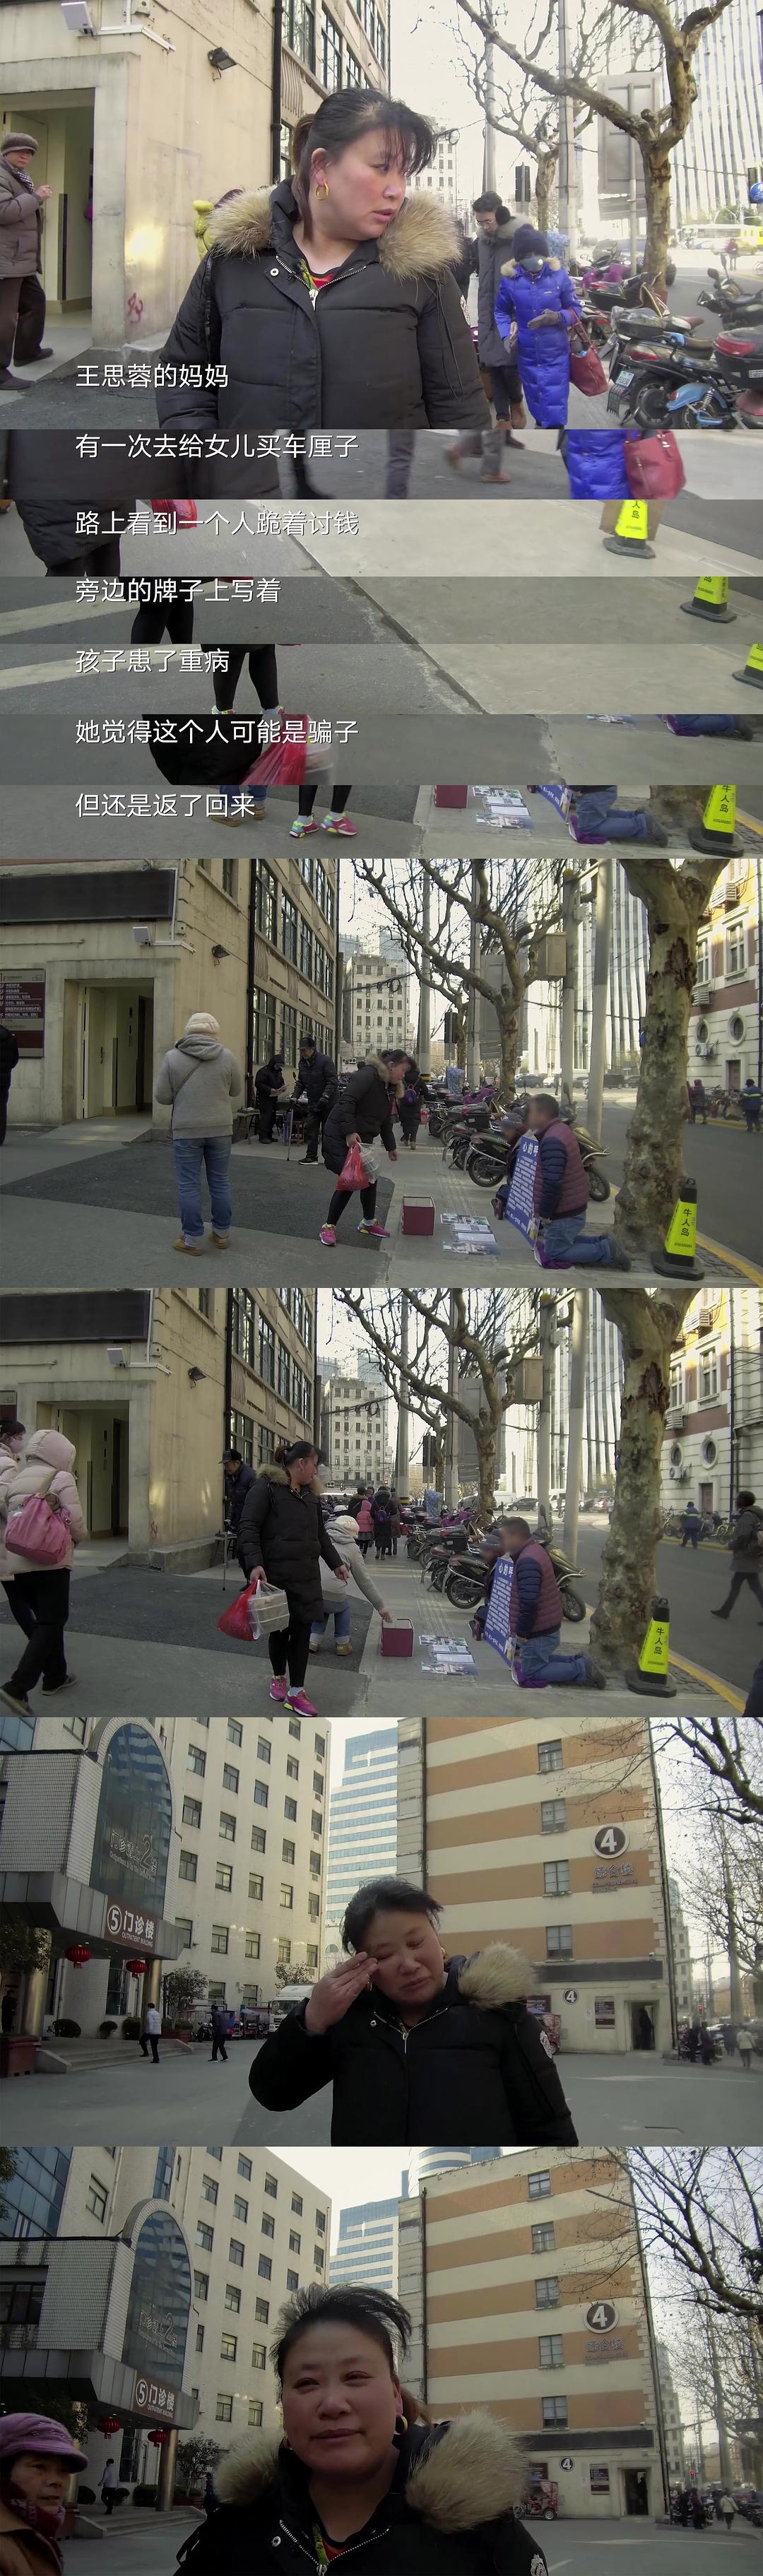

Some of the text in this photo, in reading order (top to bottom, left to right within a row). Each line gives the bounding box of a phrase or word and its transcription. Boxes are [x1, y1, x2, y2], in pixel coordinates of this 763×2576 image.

[680, 1208, 693, 1236] 牛人岛
[654, 1627, 665, 1655] 牛人岛
[123, 1910, 155, 1940] 门诊楼
[148, 2383, 175, 2411] 门诊楼
